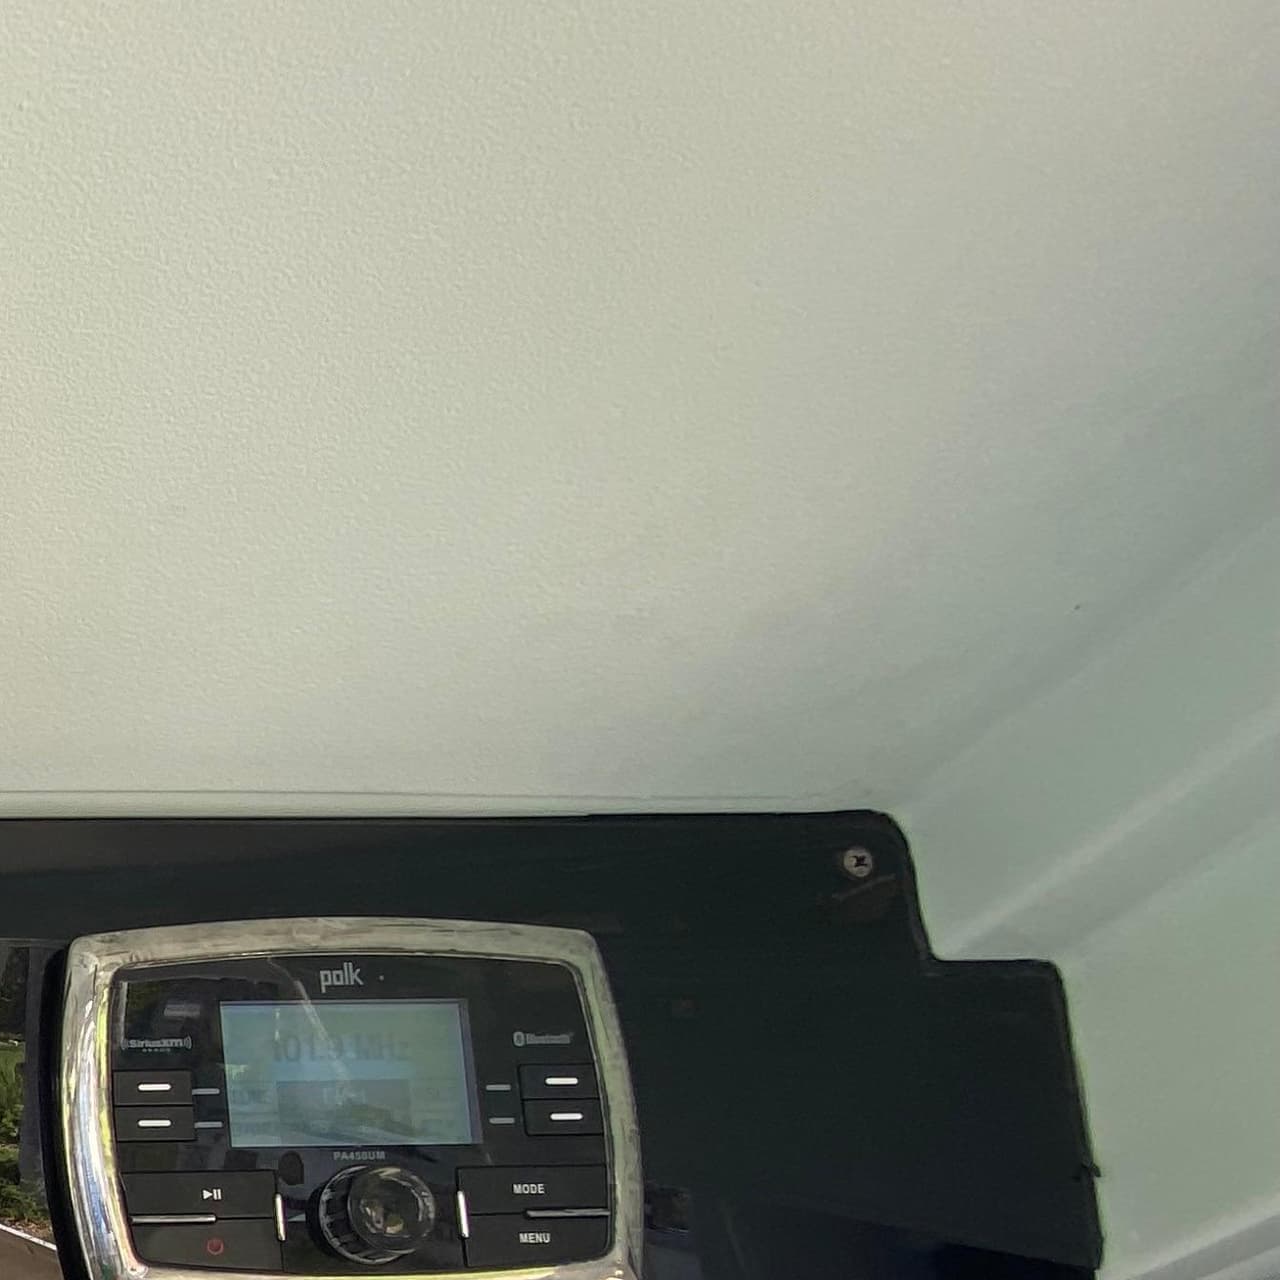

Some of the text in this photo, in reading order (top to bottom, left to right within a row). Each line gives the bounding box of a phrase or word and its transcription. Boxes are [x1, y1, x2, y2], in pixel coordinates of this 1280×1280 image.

[320, 962, 364, 993] polk
[513, 1183, 545, 1194] MODE
[519, 1232, 551, 1243] MENU
